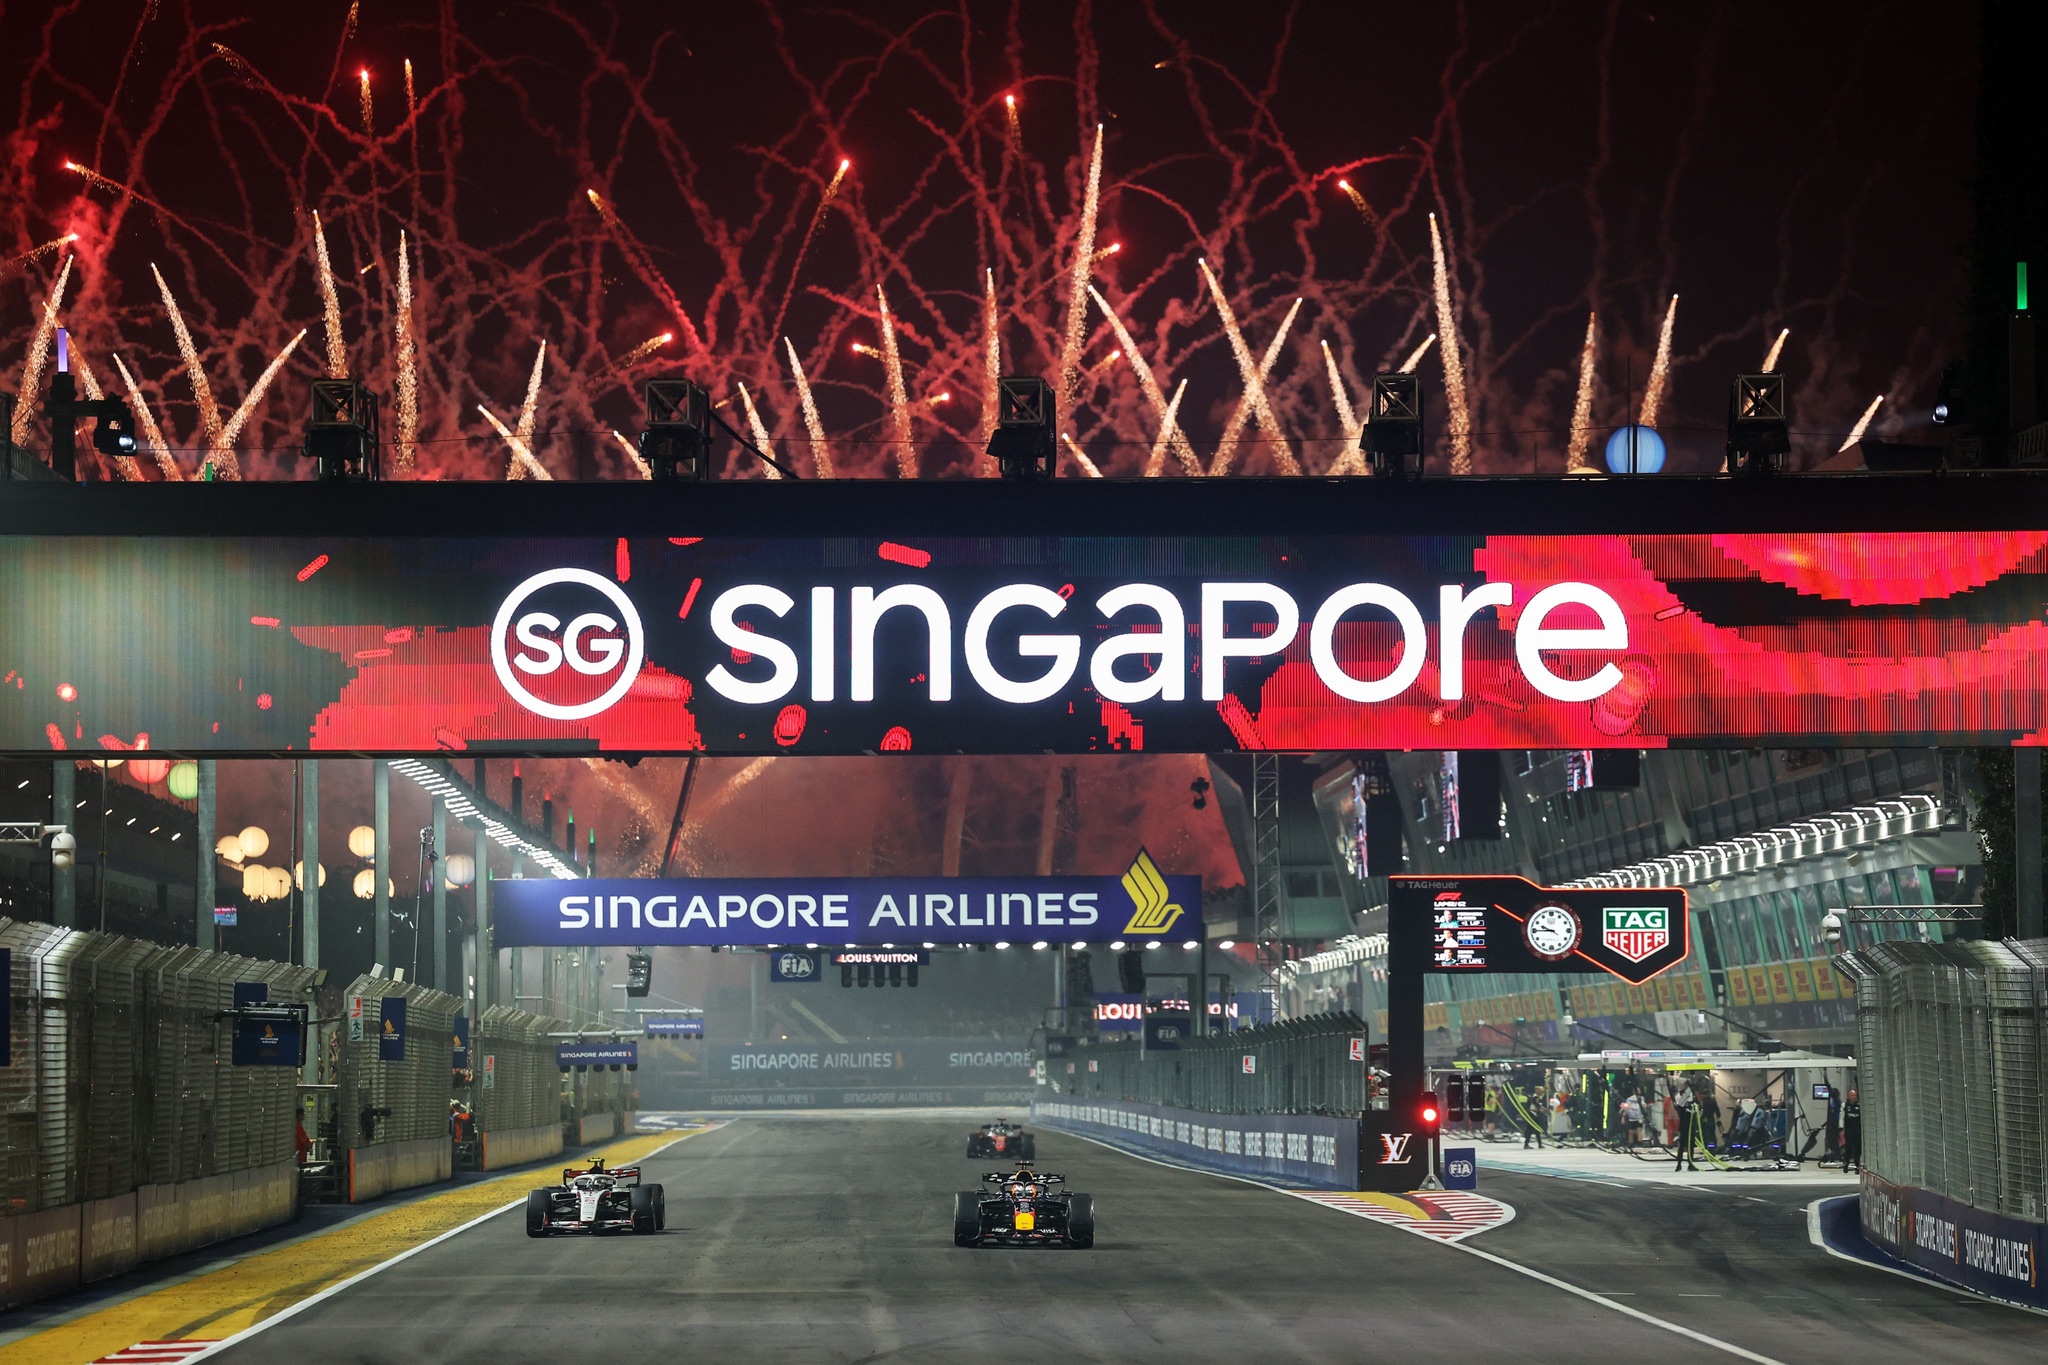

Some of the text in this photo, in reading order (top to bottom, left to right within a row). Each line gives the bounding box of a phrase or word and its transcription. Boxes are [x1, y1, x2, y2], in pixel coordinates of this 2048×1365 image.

[513, 612, 625, 675] SG
[559, 893, 1099, 929] SINGAPORE AIRLINES
[1608, 912, 1664, 928] TAG
[1607, 932, 1665, 958] HEUER
[841, 954, 918, 963] LOUIS VUITTON
[730, 1053, 892, 1070] SINGAPORE AIRLINES
[950, 1052, 1030, 1068] SINGAPORE
[1965, 1228, 2030, 1282] SINGAPORE AIRLINES
